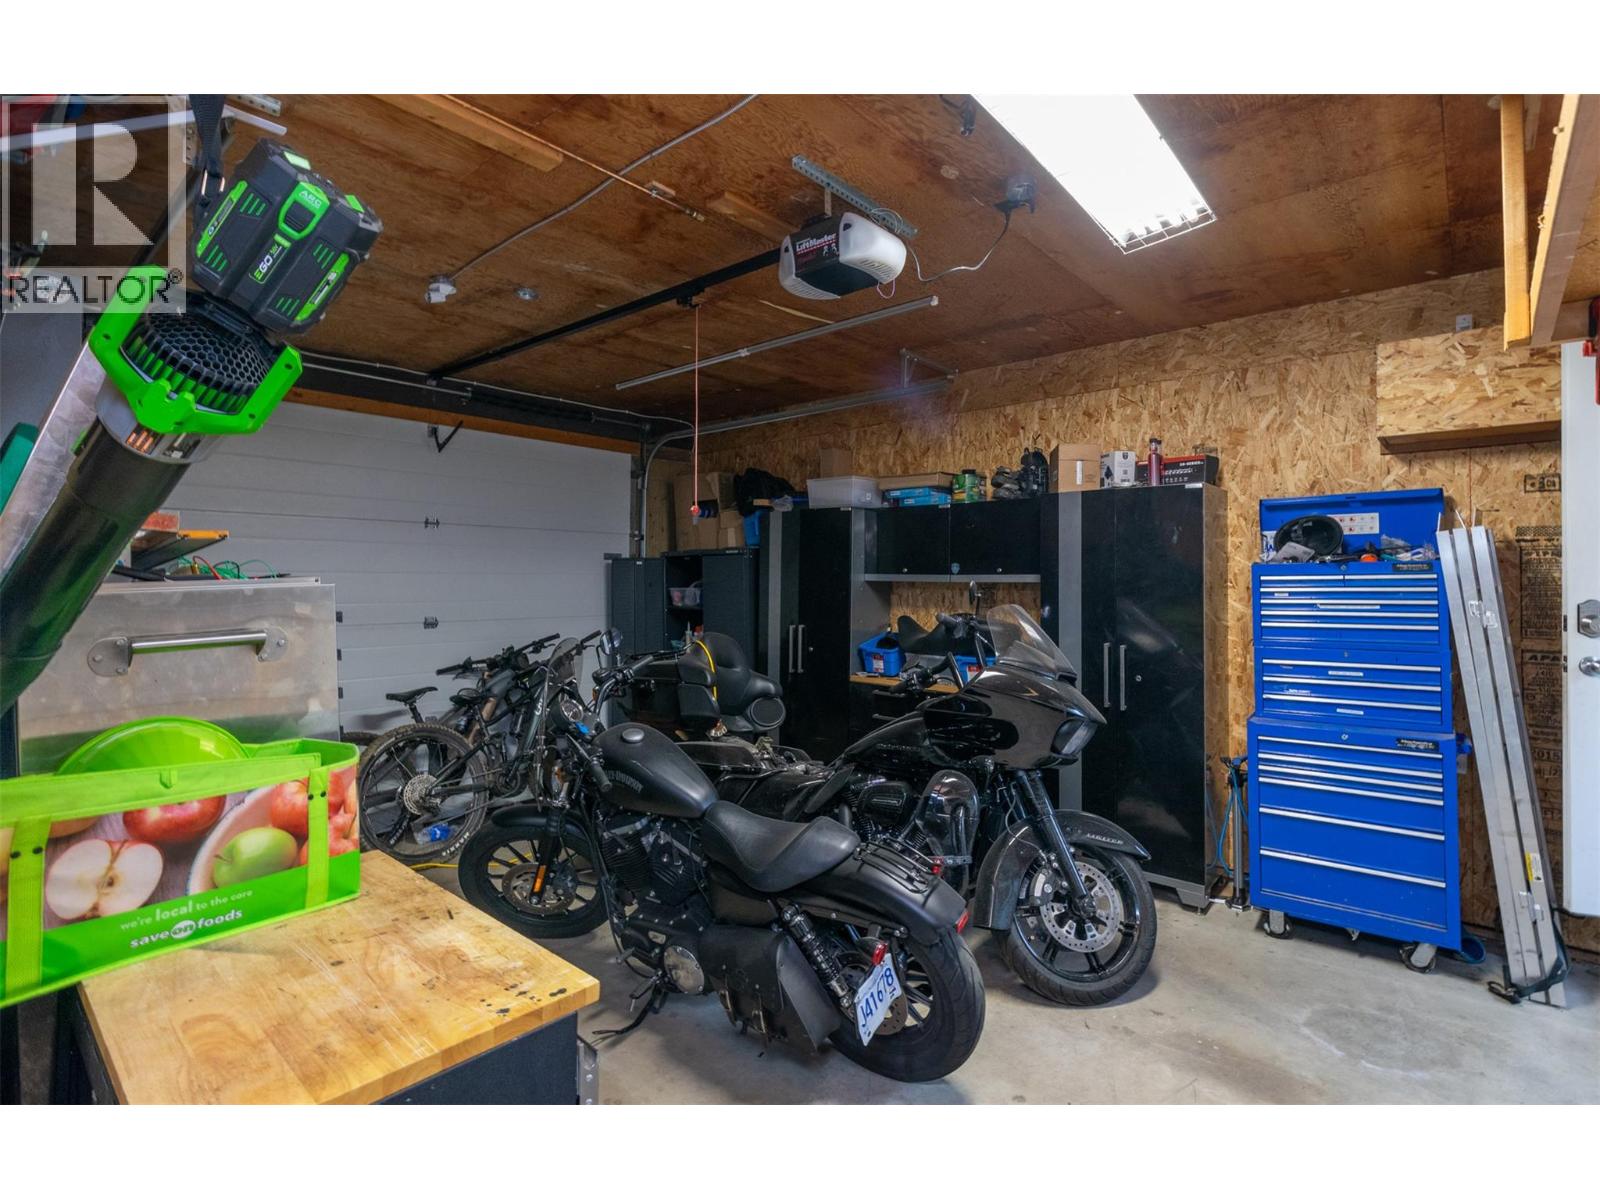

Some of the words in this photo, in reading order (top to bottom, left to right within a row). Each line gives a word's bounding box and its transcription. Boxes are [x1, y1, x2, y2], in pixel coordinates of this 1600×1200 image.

[796, 233, 838, 252] LiftMaster
[254, 254, 274, 281] EGO
[120, 915, 153, 931] we're
[155, 899, 194, 921] local
[196, 901, 208, 911] to
[210, 895, 229, 907] the
[230, 889, 254, 902] core
[129, 929, 171, 949] save
[197, 908, 244, 929] foods
[859, 966, 895, 1028] J41678
